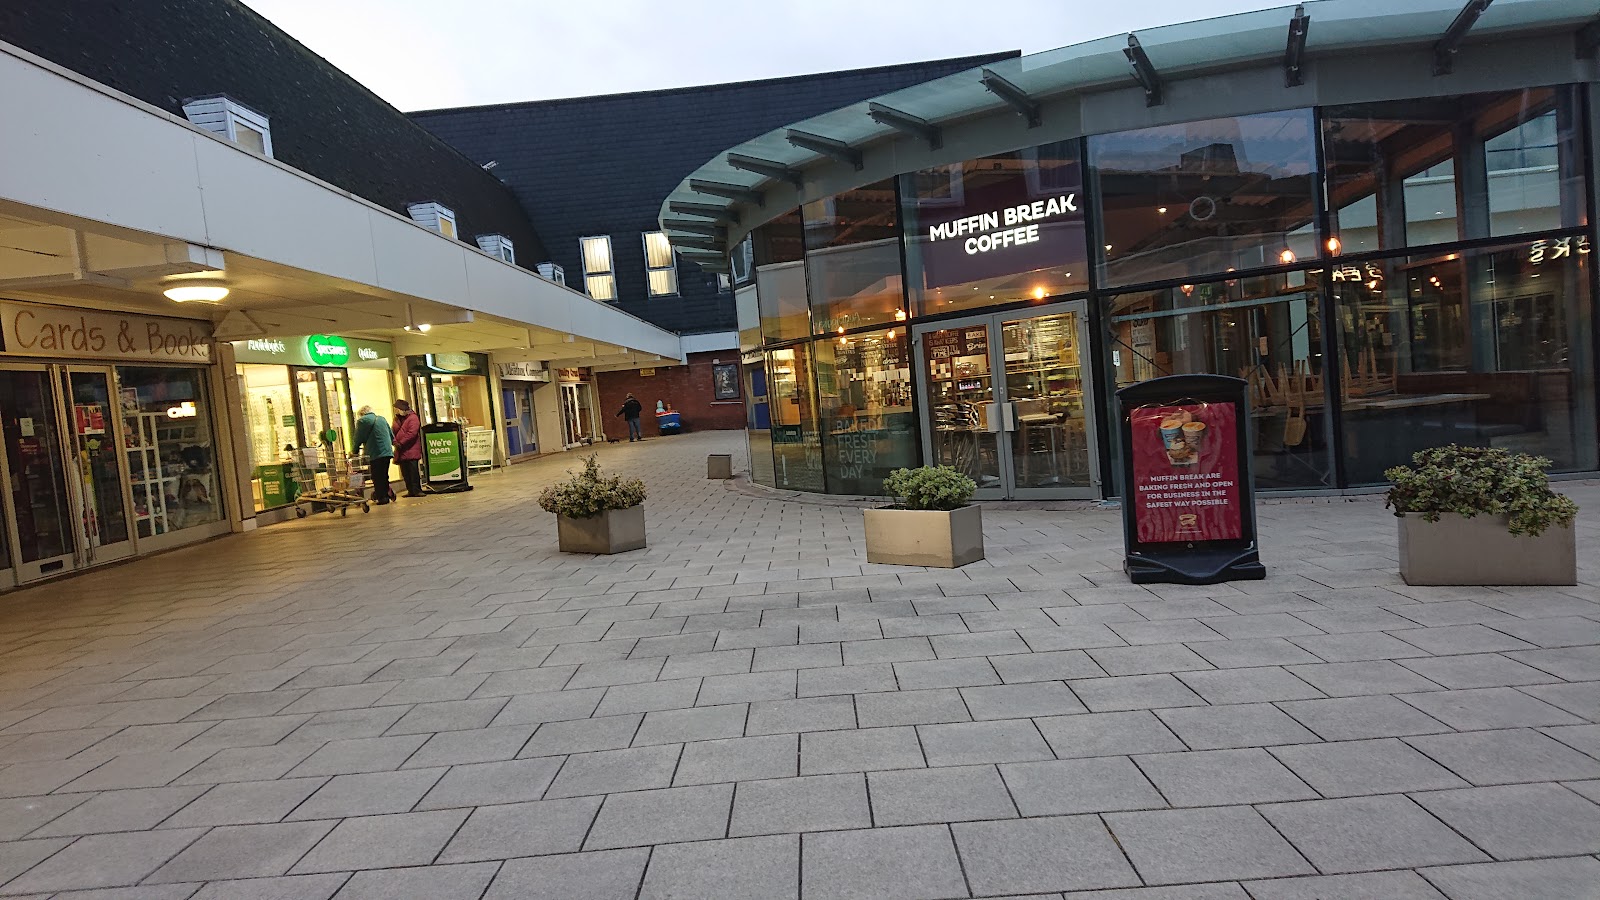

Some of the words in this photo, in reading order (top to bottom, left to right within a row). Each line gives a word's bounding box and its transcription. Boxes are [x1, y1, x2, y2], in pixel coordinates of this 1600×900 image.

[929, 210, 999, 242] MUFFIN
[1003, 193, 1077, 226] BREAK
[964, 224, 1040, 255] COFFEE
[14, 309, 106, 352] Cards
[117, 319, 137, 354] &
[145, 321, 213, 357] Books
[314, 341, 347, 356] Specsavers
[836, 418, 878, 431] BAKED
[429, 438, 452, 447] We're
[837, 434, 878, 449] FRESH
[430, 447, 451, 455] open
[839, 449, 878, 464] EVERY
[840, 464, 864, 479] DAY
[1163, 491, 1200, 499] BUSINESS
